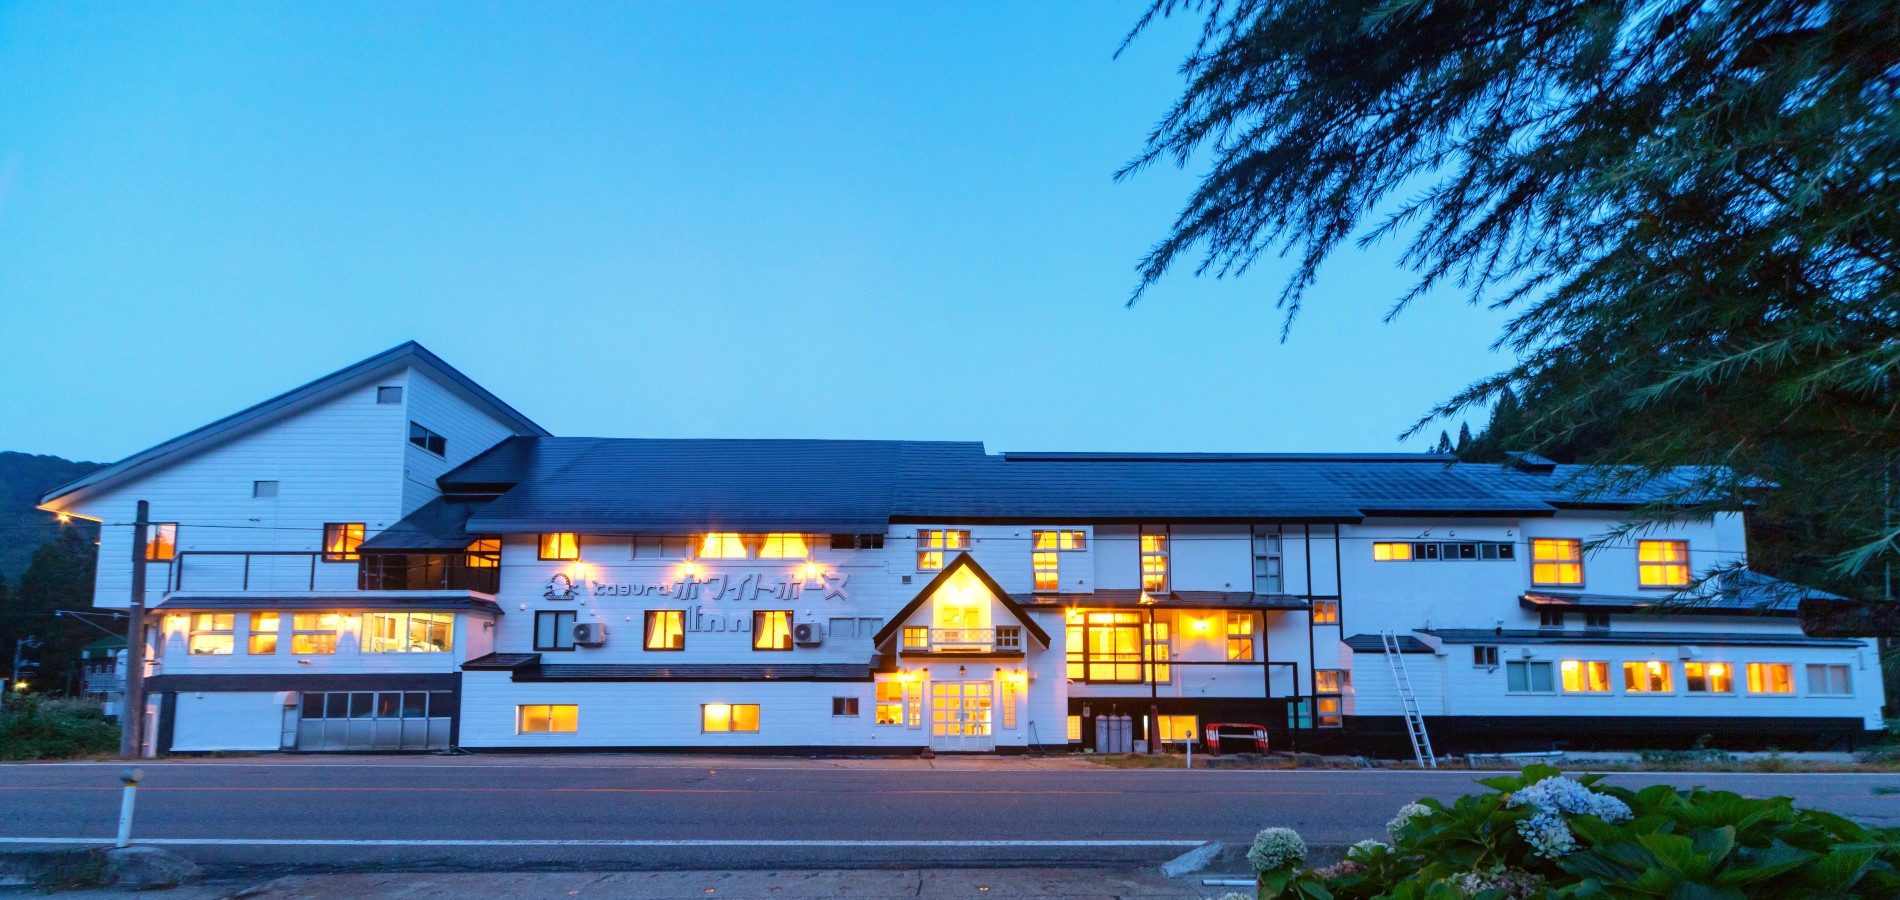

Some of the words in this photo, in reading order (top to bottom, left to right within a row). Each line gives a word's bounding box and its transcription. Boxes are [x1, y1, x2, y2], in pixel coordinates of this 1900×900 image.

[672, 573, 851, 601] ホワイトホース
